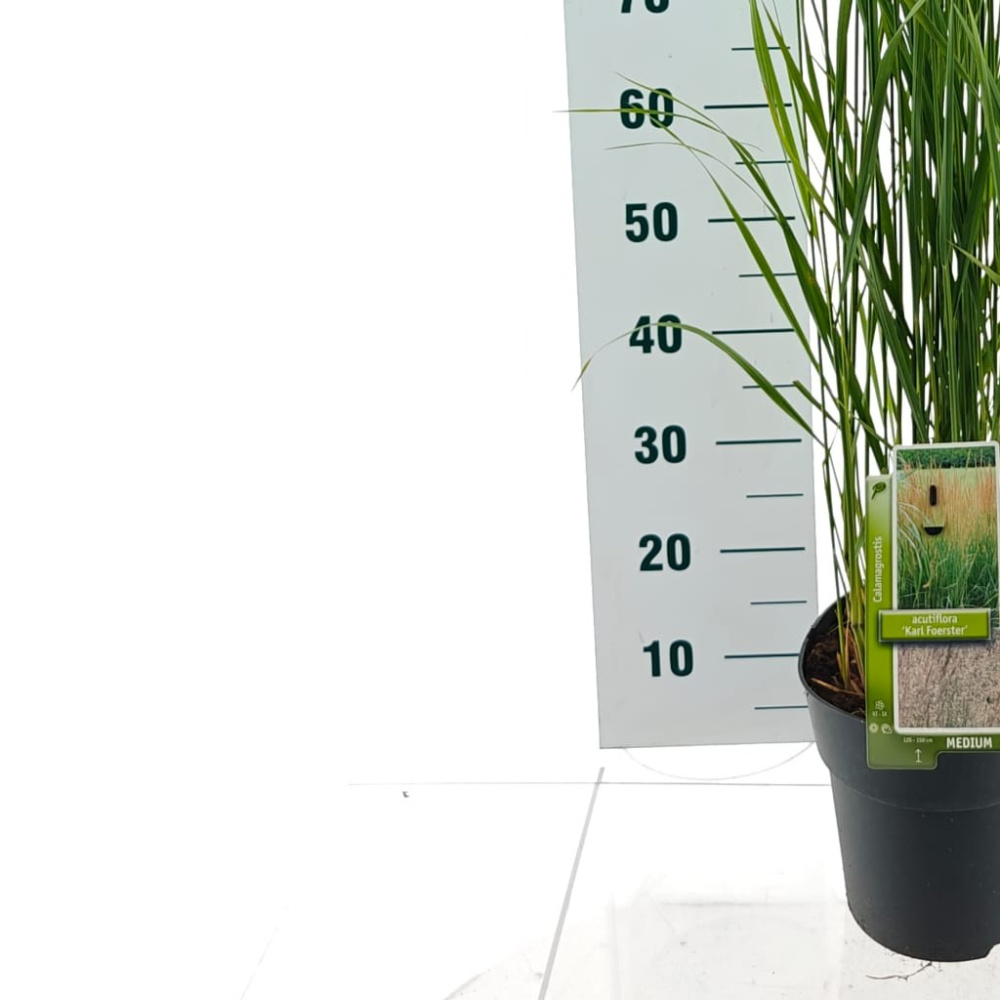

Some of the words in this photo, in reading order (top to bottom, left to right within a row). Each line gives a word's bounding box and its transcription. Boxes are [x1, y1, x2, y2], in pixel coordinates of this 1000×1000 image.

[619, 88, 674, 130] 60
[625, 202, 679, 243] 50
[628, 314, 683, 354] 40
[634, 425, 687, 464] 30
[638, 533, 691, 572] 20
[873, 535, 885, 603] Calamagrostis
[911, 613, 958, 625] acutiflora
[642, 639, 694, 678] 10
[946, 736, 993, 749] MEDIUM
